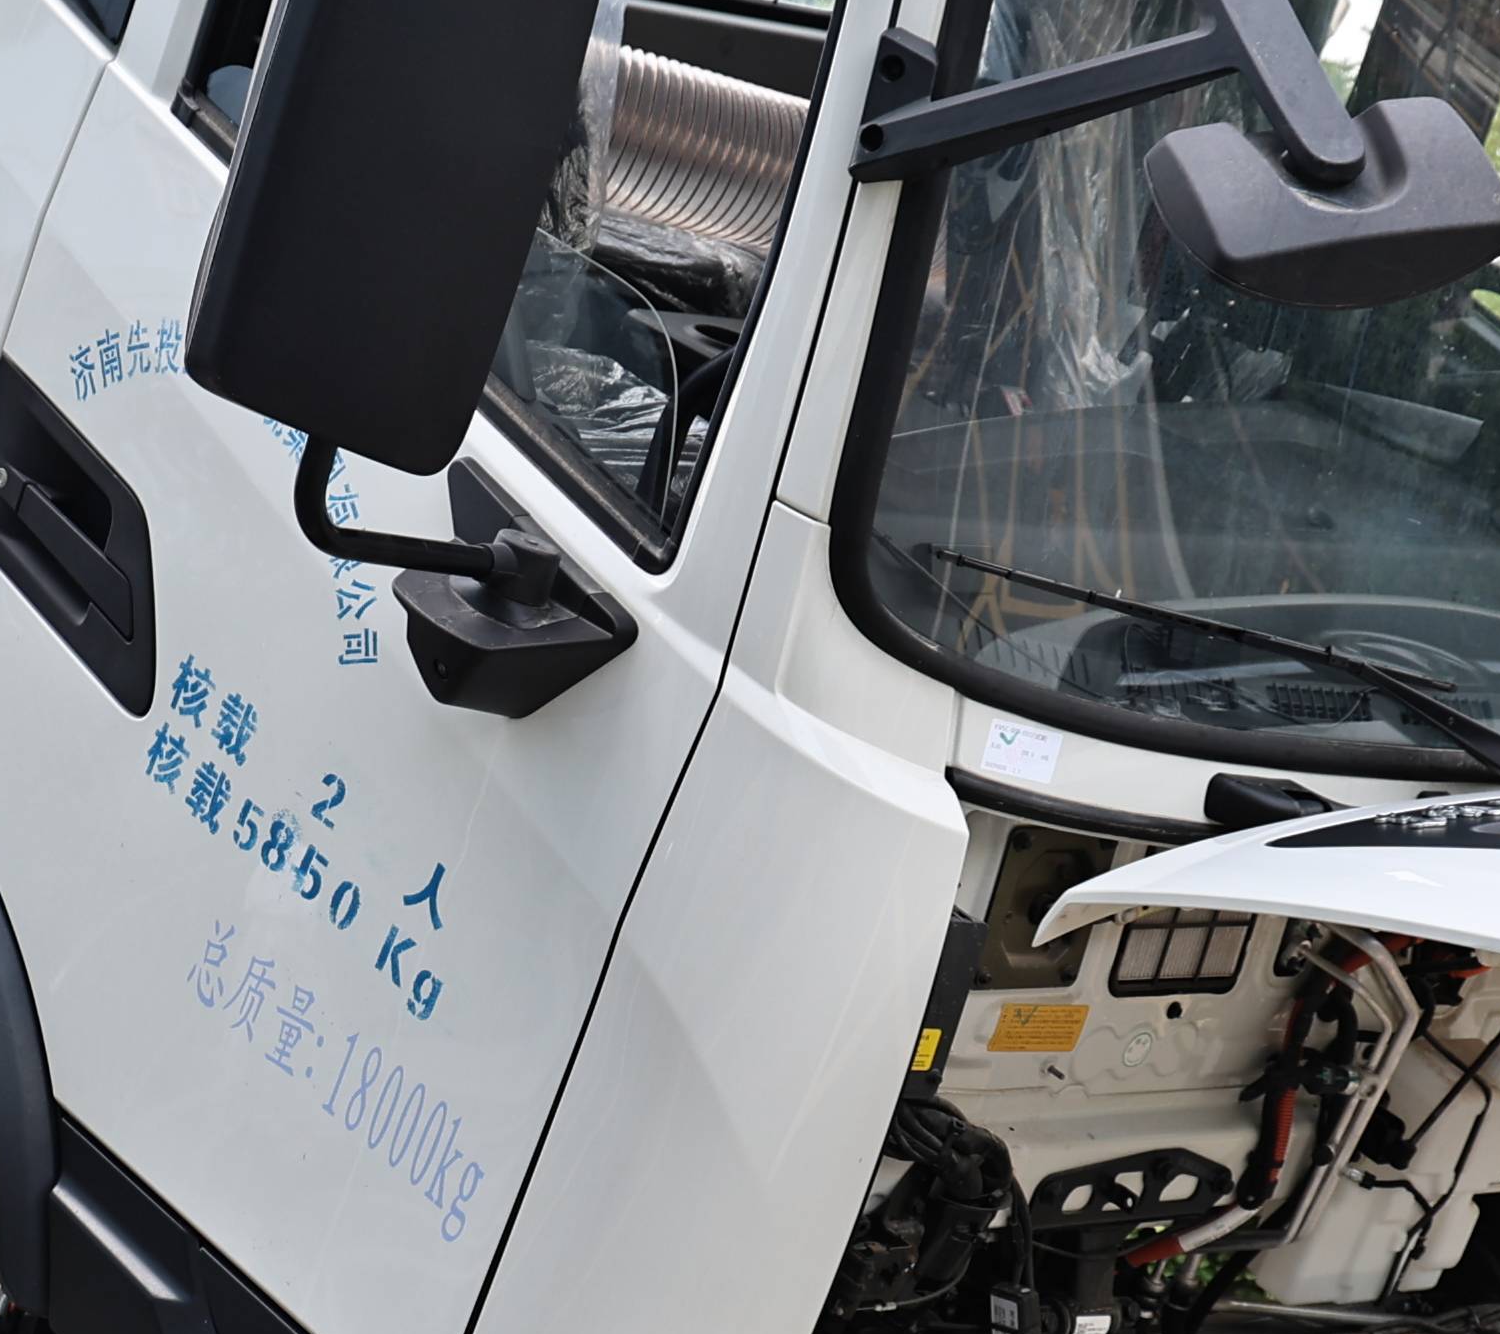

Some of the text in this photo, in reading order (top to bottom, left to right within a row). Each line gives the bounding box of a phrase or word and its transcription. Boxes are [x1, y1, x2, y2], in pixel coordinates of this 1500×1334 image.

[170, 653, 447, 931] 核载 2 人
